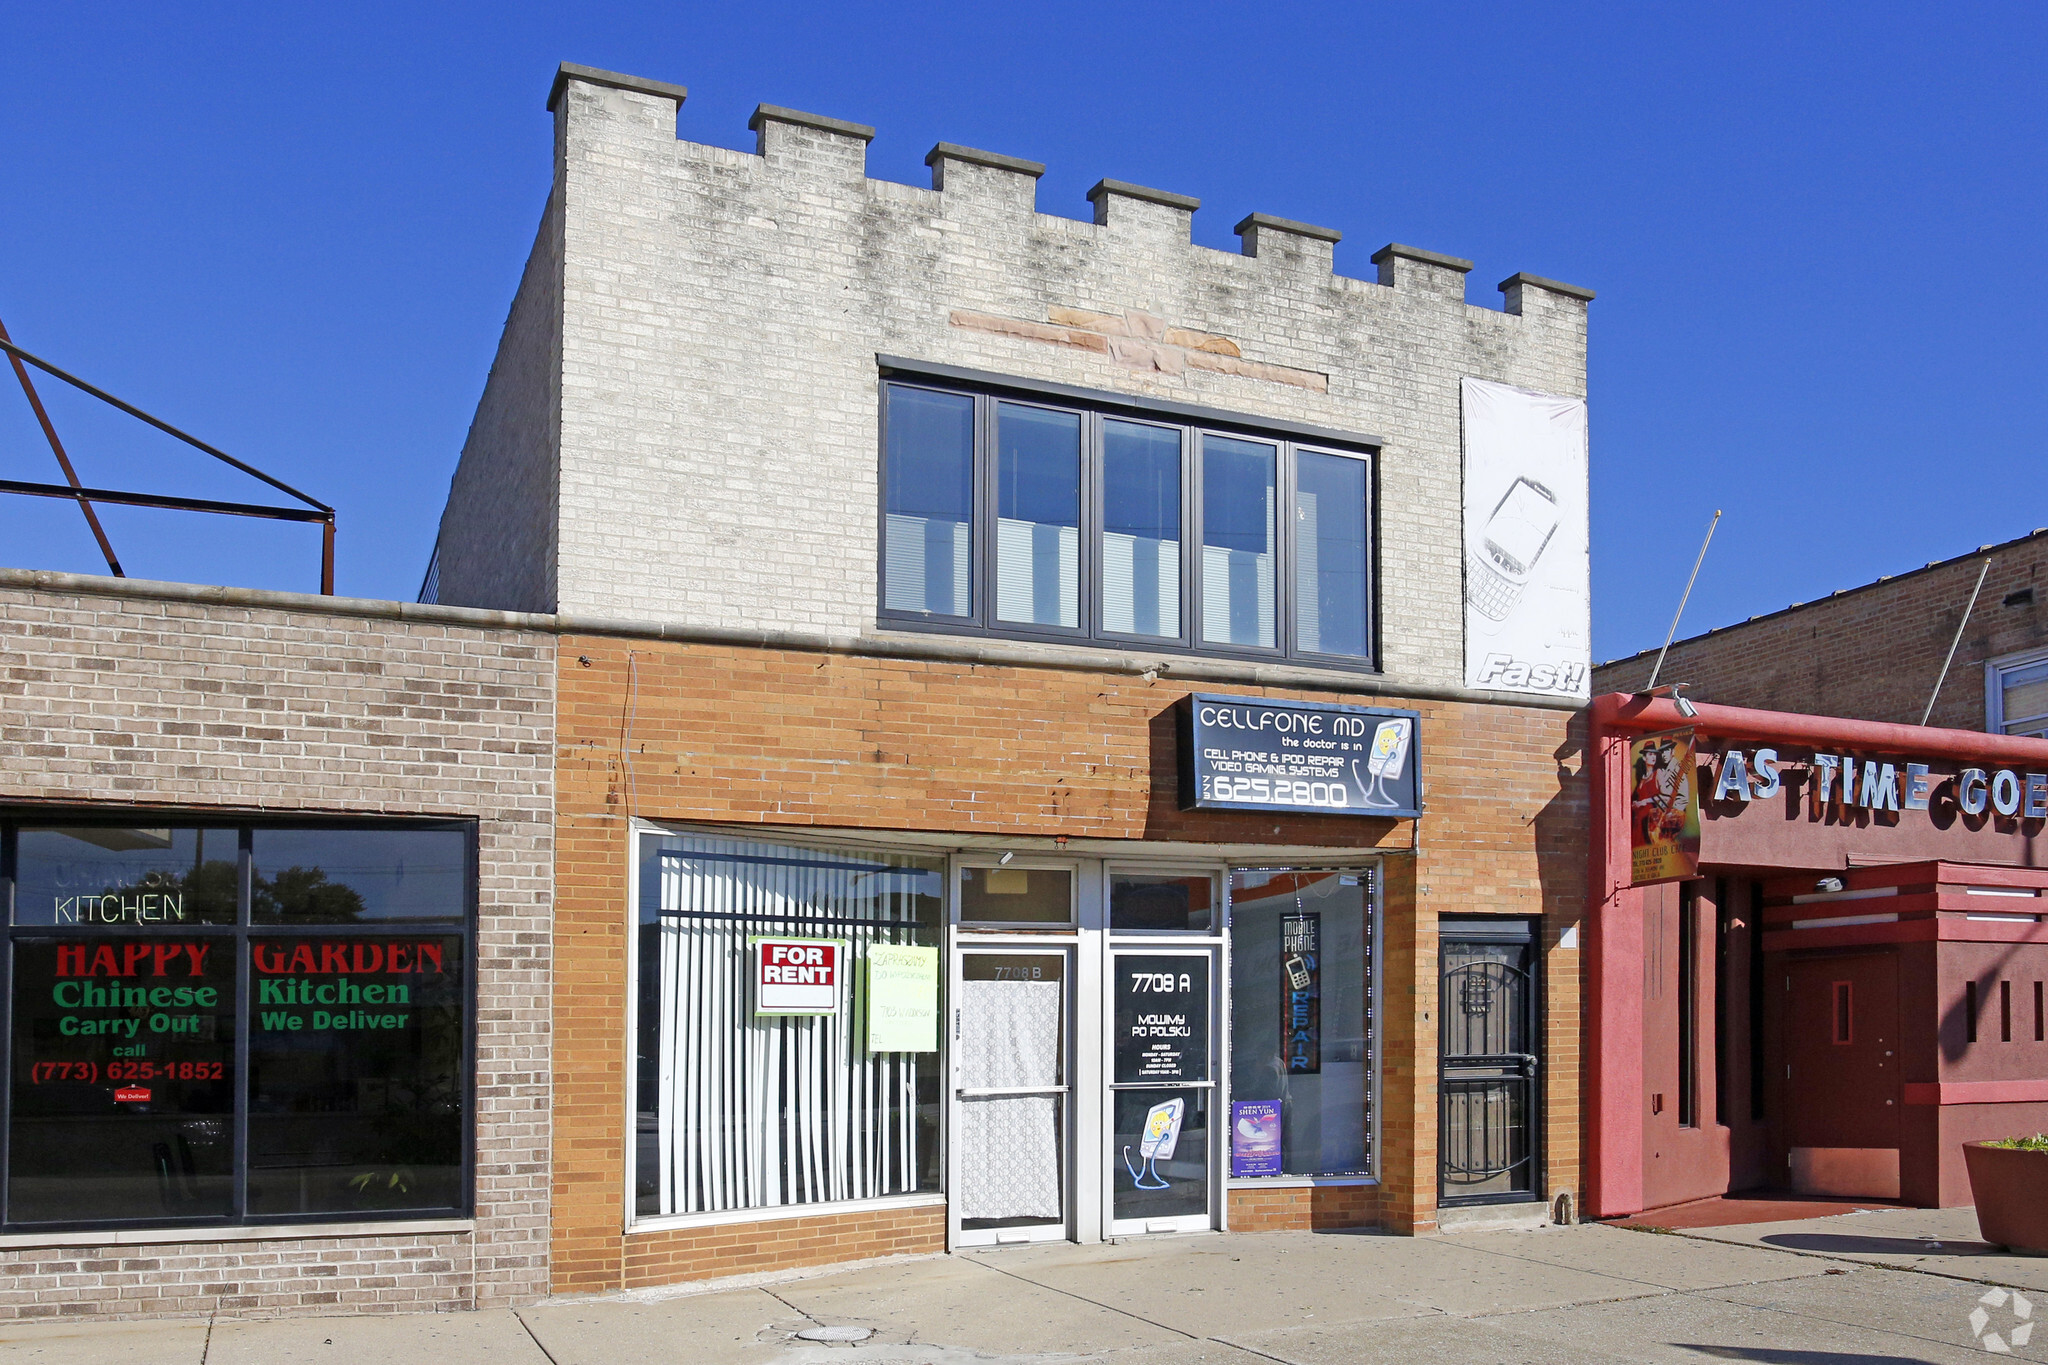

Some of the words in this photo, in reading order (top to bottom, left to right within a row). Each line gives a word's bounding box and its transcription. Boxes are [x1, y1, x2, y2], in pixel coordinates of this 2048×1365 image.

[1477, 652, 1585, 693] Fast!
[1199, 707, 1323, 734] CELLFONE
[1333, 717, 1366, 737] MD
[1281, 736, 1299, 748] the
[1303, 737, 1337, 750] doctor
[1341, 742, 1350, 751] is
[1353, 742, 1363, 751] in
[1204, 748, 1229, 760] CELL
[1231, 750, 1268, 763] PHONE
[1270, 753, 1279, 764] &
[1281, 753, 1305, 765] IPOD
[1307, 755, 1345, 767] REPAIR
[1210, 760, 1242, 772] VIDEO
[1245, 762, 1286, 775] GAMING
[1288, 765, 1339, 778] SYSTEMS
[1713, 748, 1781, 801] AS
[1814, 753, 1930, 811] TIME
[1652, 845, 1669, 857] CLUB
[55, 894, 183, 924] KITCHEN
[1284, 919, 1315, 936] MOBILE
[1284, 935, 1316, 952] PHONE
[55, 942, 211, 977] HAPPY
[253, 940, 443, 974] GARDEN
[772, 946, 824, 965] FOR
[764, 965, 832, 984] RENT
[994, 967, 1029, 979] 7708
[1032, 967, 1042, 979] B
[1131, 973, 1175, 992] 7708
[1179, 973, 1191, 992] A
[52, 980, 218, 1008] Chinese
[258, 978, 410, 1004] Kitchen
[59, 1016, 141, 1038] Carry
[149, 1013, 200, 1033] Out
[261, 1011, 303, 1031] We
[313, 1010, 409, 1030] Deliver
[1138, 1014, 1186, 1025] MOWIMY
[1132, 1026, 1147, 1037] PO
[1150, 1026, 1191, 1037] POLSKU
[1291, 991, 1310, 1069] REPAIR
[112, 1044, 146, 1057] call
[31, 1062, 98, 1084] (773)
[106, 1062, 224, 1080] 625-1852
